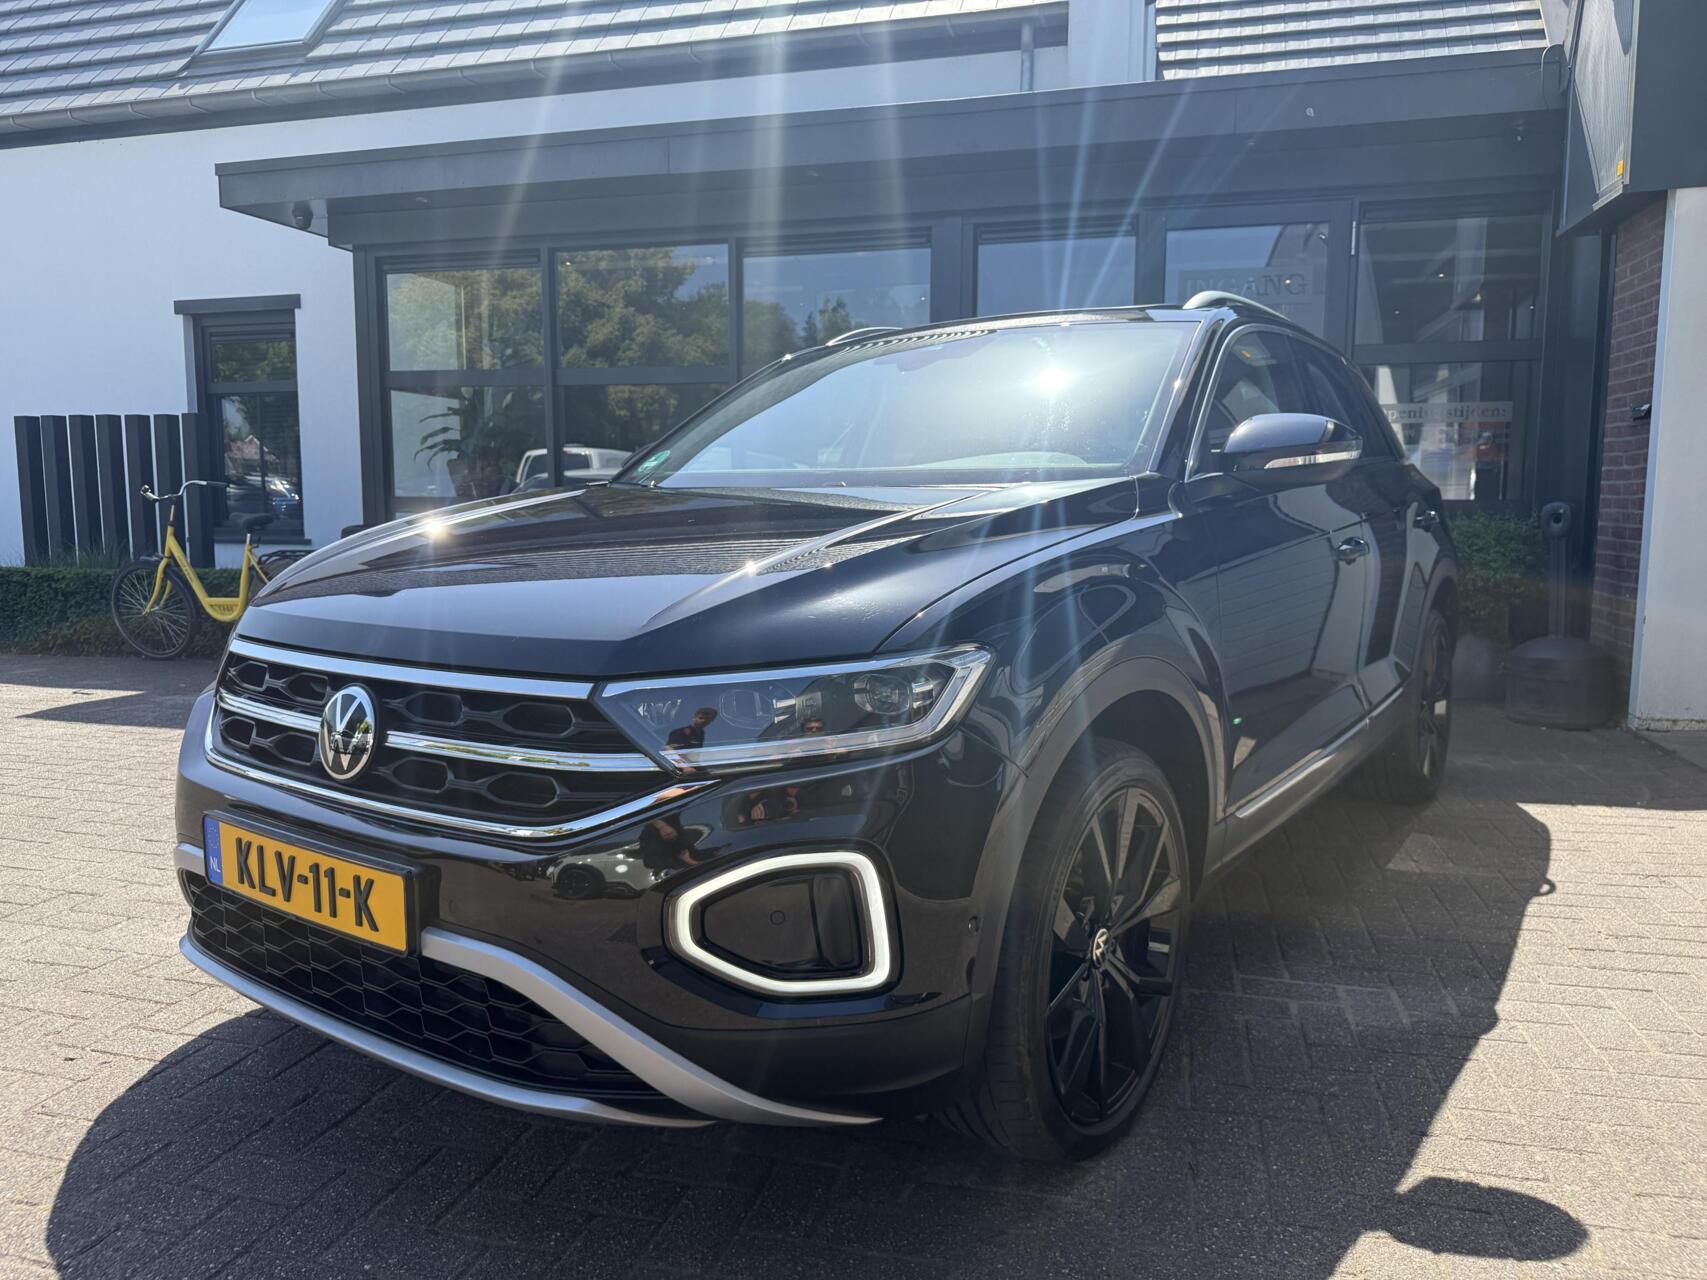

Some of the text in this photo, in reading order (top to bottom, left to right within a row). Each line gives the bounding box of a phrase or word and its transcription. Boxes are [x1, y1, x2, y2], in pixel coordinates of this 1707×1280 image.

[1187, 273, 1307, 297] INGANG
[1385, 405, 1506, 421] penistijden:
[209, 855, 221, 873] NL
[235, 837, 379, 932] KLV-11-K
